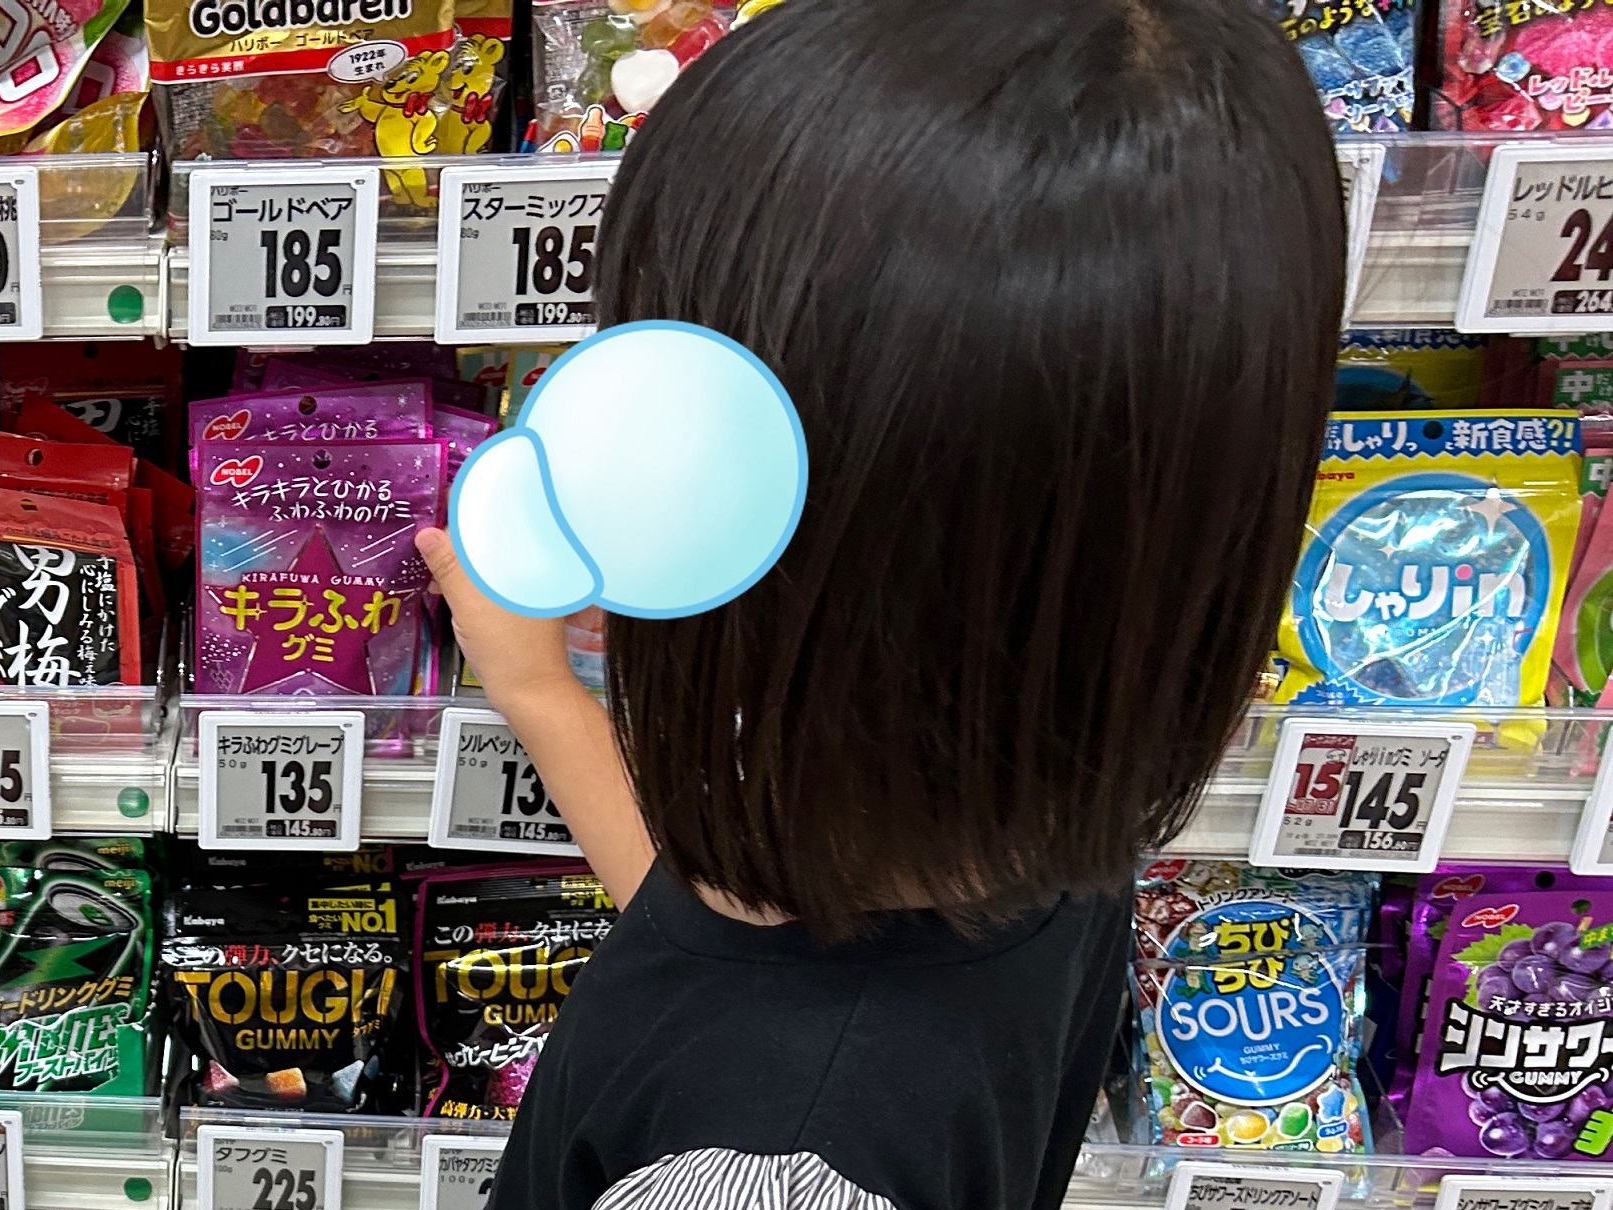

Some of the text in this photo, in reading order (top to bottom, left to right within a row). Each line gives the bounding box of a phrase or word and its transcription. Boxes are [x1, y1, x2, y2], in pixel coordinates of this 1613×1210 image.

[213, 197, 353, 222] ゴールドベア
[260, 229, 342, 298] 185
[512, 225, 597, 295] 185
[220, 466, 254, 478] NOBEL
[231, 478, 392, 510] キラキラとひかる
[268, 499, 413, 522] ふわふわのグミ
[242, 574, 385, 587] KIRAFUWA GUMMY
[1326, 562, 1527, 622] しゃりin
[3, 543, 82, 686] 男梅
[95, 555, 117, 652] 手塩にかけた
[220, 585, 401, 633] キラふわ
[282, 634, 336, 663] グミ
[218, 735, 344, 755] キラふわグミグレープ
[460, 735, 529, 756] ソルベット
[262, 761, 333, 813] 135
[501, 761, 561, 817] 13
[1294, 761, 1345, 799] 15
[1339, 771, 1427, 829] 145
[1214, 918, 1292, 954] ちび
[174, 968, 397, 1026] TOUGH
[1171, 988, 1329, 1041] SOURS
[235, 1028, 340, 1050] GUMMY
[1243, 1043, 1280, 1054] GUMMY
[1509, 1071, 1582, 1086] GUMMY
[216, 1147, 287, 1164] タフグミ
